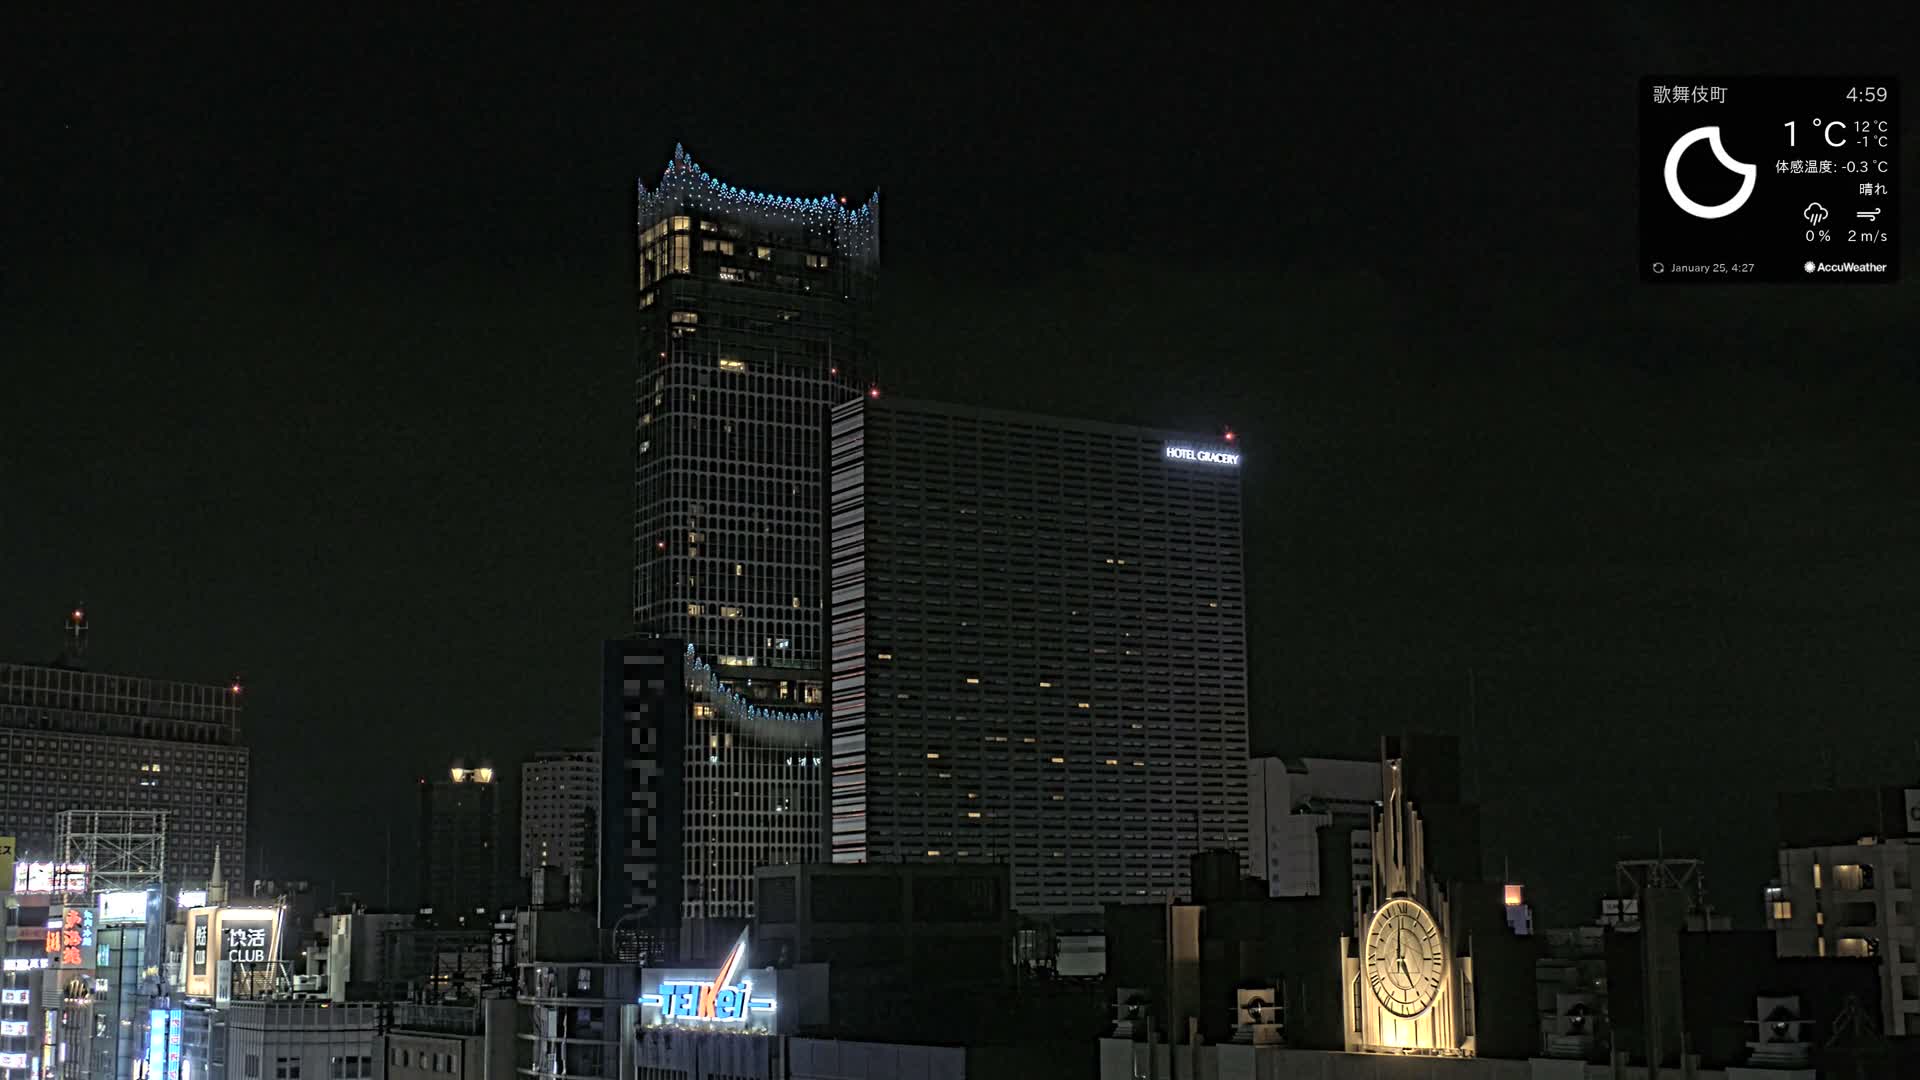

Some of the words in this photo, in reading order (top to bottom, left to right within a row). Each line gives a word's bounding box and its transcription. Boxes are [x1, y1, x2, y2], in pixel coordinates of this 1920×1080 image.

[1166, 446, 1197, 460] HOTEL
[1197, 450, 1240, 465] GRACERY
[228, 928, 266, 948] 快活
[229, 949, 265, 963] CLUB
